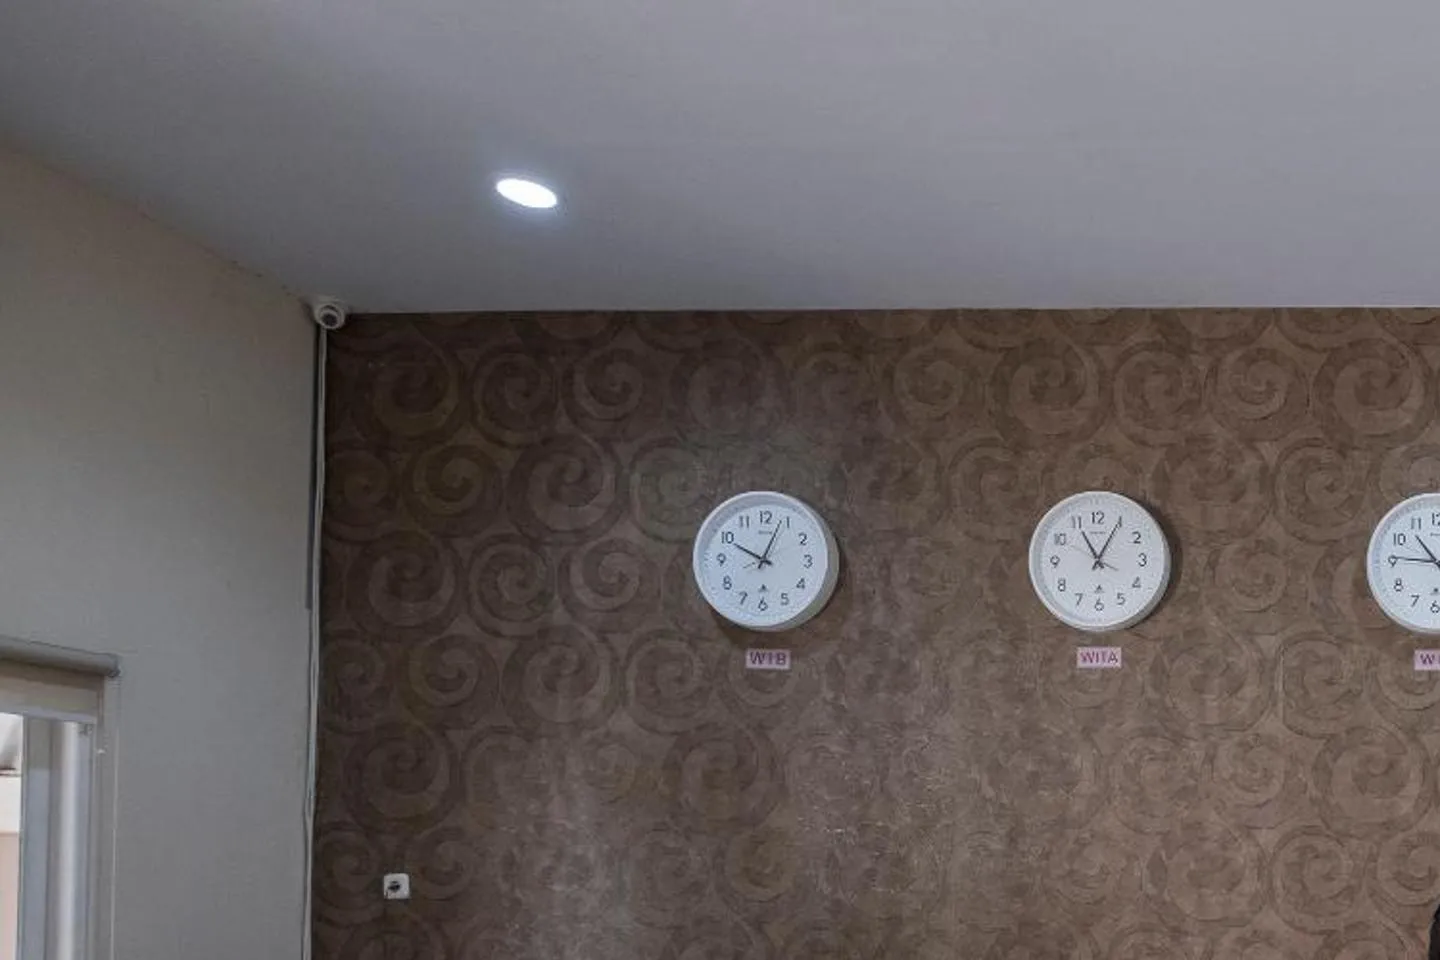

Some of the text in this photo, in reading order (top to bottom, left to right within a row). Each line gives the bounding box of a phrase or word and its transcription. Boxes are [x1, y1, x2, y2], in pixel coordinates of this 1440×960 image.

[738, 515, 750, 529] 11
[759, 510, 773, 525] 12
[1072, 516, 1082, 529] 11
[1091, 511, 1105, 525] 12
[1410, 517, 1422, 530] 11
[721, 531, 734, 544] 10
[798, 533, 808, 546] 2
[1054, 533, 1067, 546] 10
[1132, 531, 1142, 544] 2
[1393, 532, 1406, 546] 10
[716, 553, 727, 566] 9
[803, 554, 813, 569] 3
[1049, 555, 1061, 568] 9
[1138, 552, 1148, 567] 3
[1387, 555, 1397, 569] 9
[722, 575, 732, 590] 8
[796, 577, 806, 590] 4
[1057, 578, 1067, 592] 8
[1132, 576, 1141, 589] 4
[1393, 578, 1404, 593] 8
[738, 591, 748, 605] 7
[758, 596, 768, 612] 6
[780, 592, 789, 606] 5
[1074, 593, 1084, 606] 7
[1094, 598, 1105, 612] 6
[1116, 593, 1126, 606] 5
[1410, 595, 1420, 608] 7
[1430, 600, 1440, 614] 6
[750, 652, 786, 666] WIB
[1080, 651, 1119, 663] WITA
